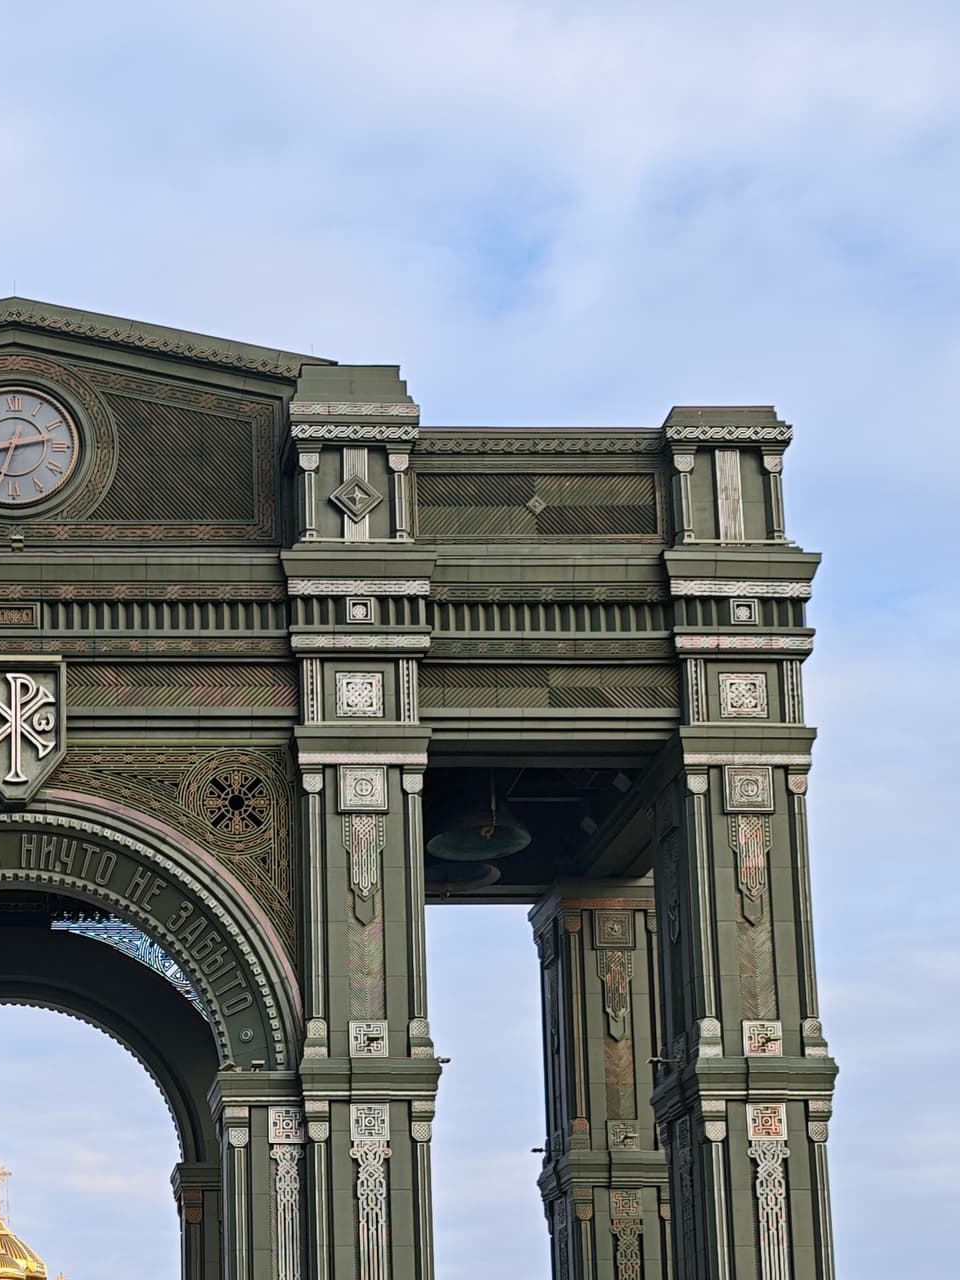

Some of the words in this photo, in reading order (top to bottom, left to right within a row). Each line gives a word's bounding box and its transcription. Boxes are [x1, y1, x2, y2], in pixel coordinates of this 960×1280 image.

[20, 834, 117, 885] НИЧТО
[125, 866, 167, 911] НЕ
[166, 901, 253, 1016] ЗАБЫТО
